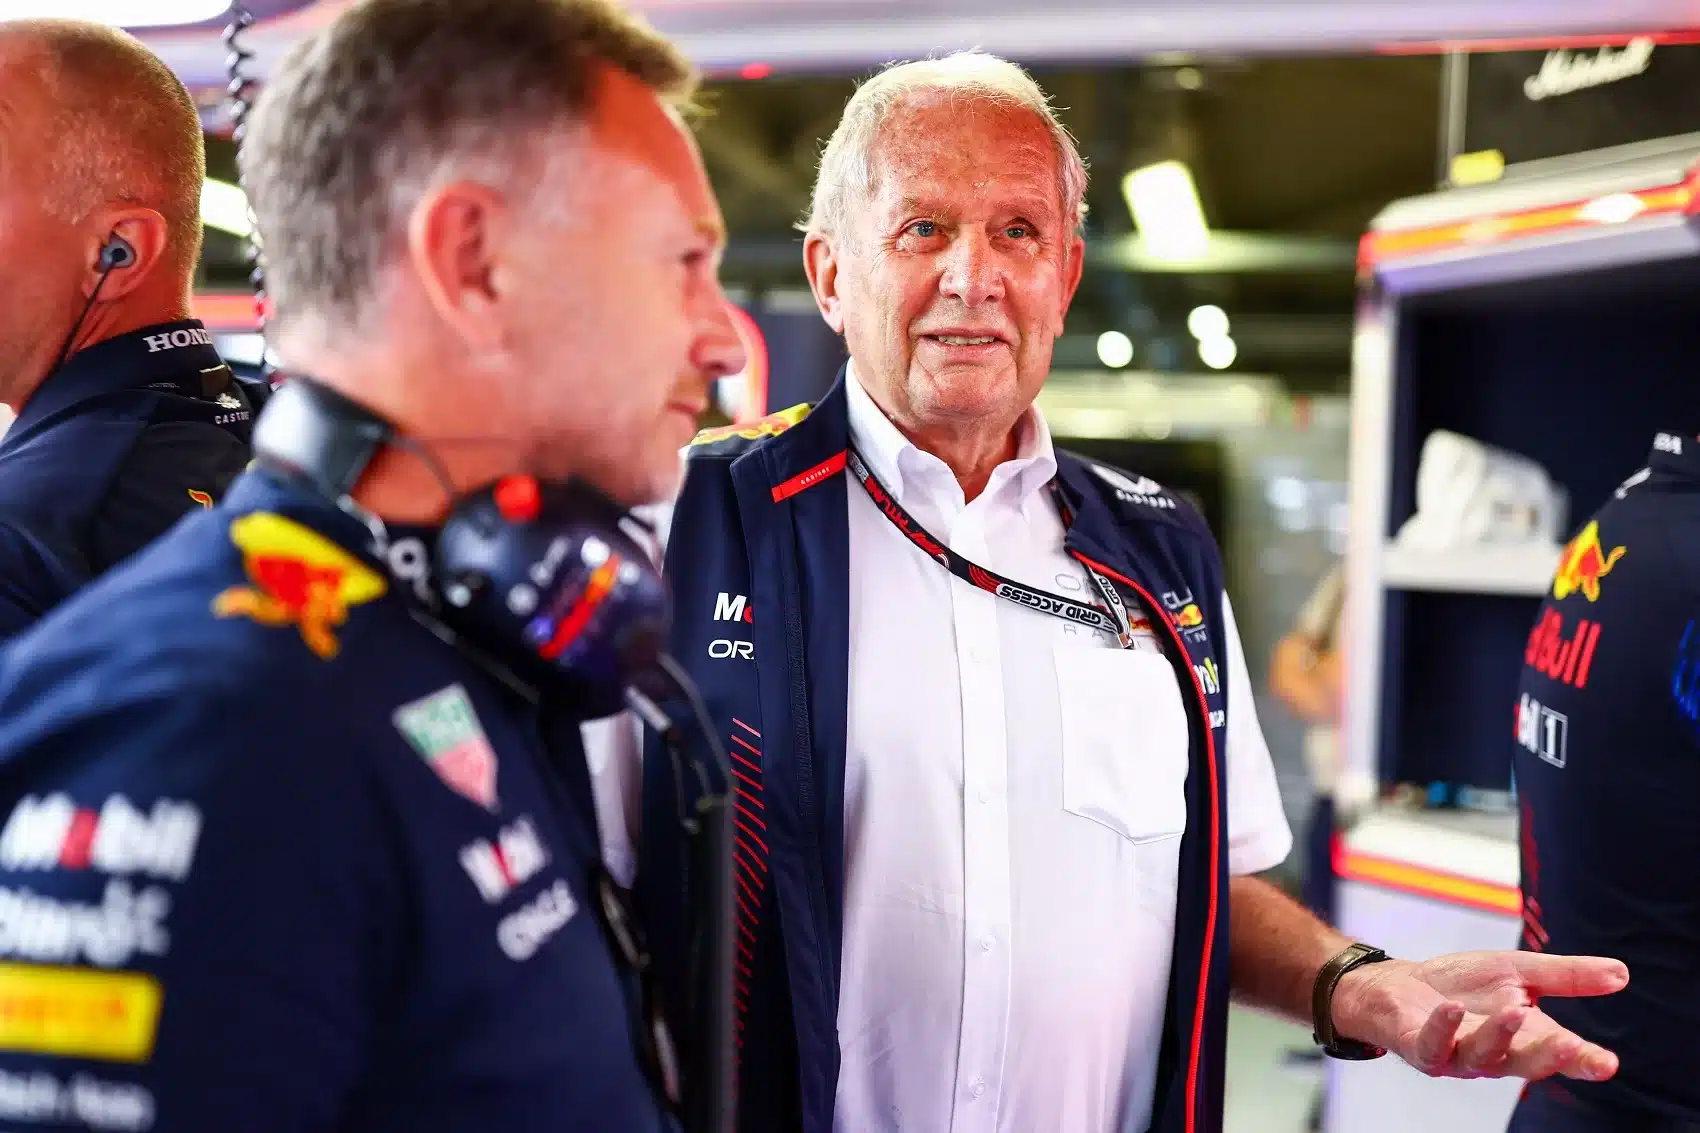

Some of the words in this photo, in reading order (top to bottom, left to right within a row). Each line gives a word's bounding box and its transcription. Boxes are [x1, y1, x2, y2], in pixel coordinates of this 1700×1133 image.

[1000, 584, 1064, 613] ACCESS
[1097, 576, 1120, 605] GRID
[1065, 605, 1103, 625] GRID
